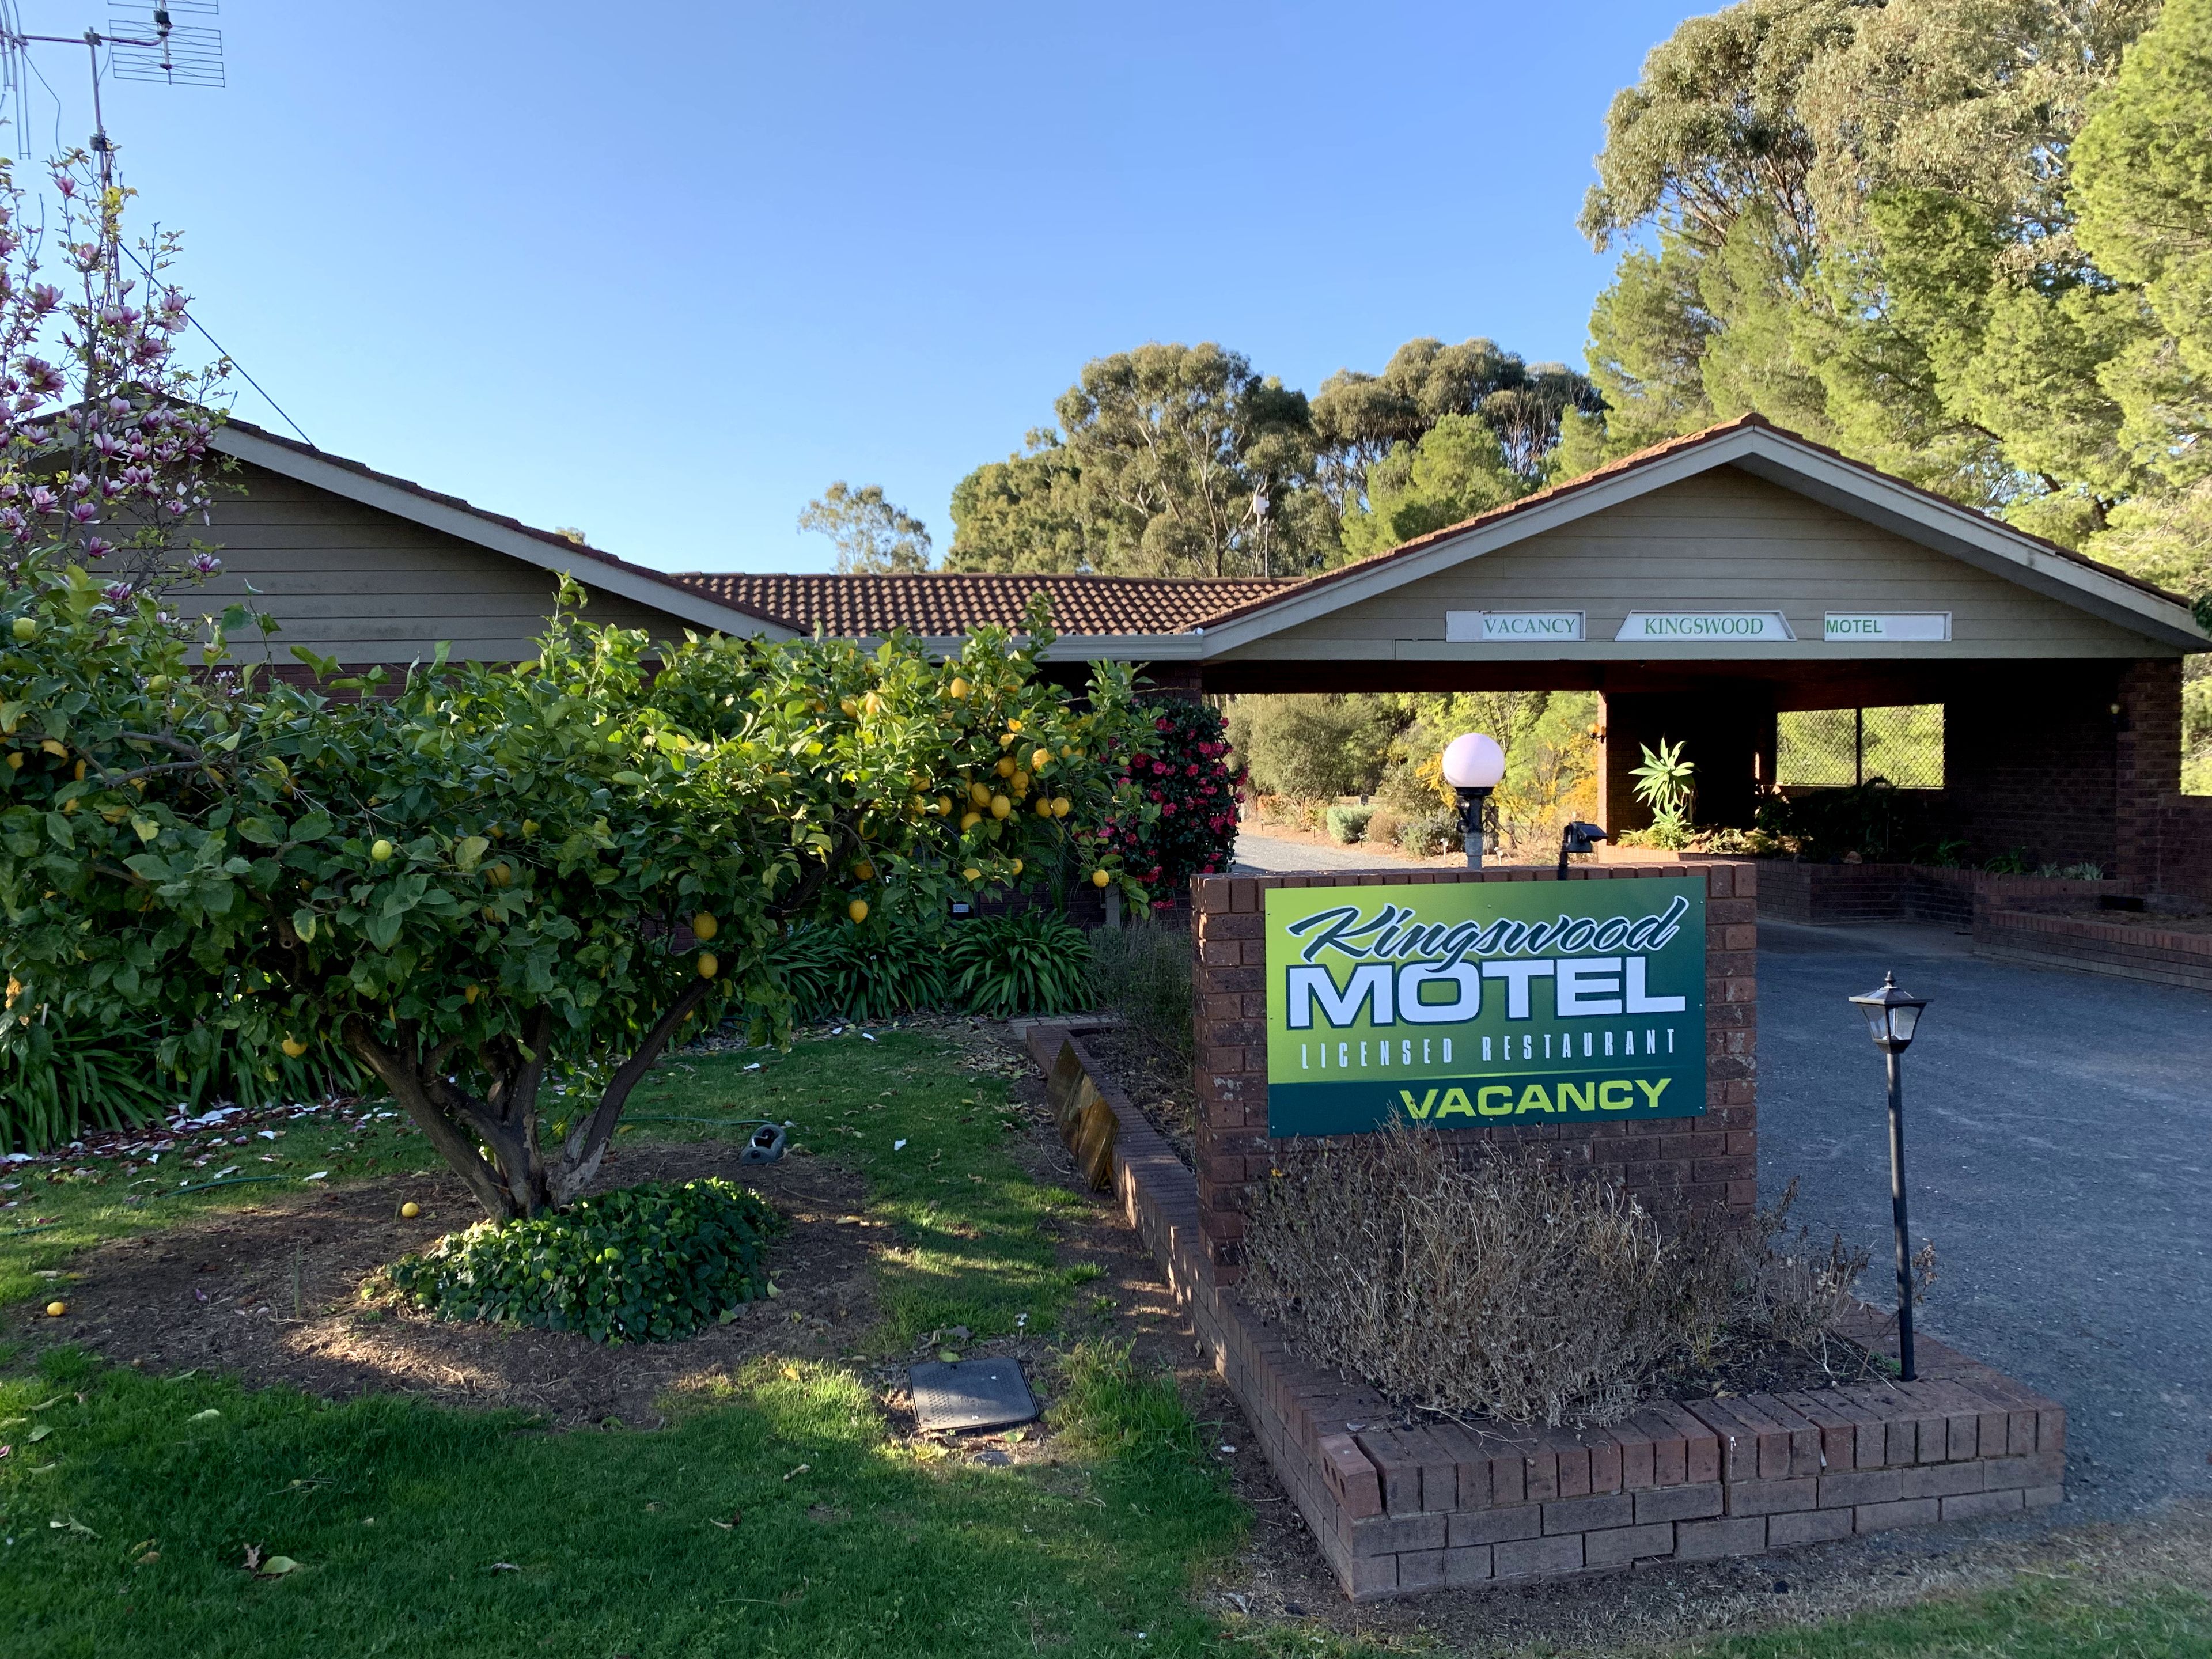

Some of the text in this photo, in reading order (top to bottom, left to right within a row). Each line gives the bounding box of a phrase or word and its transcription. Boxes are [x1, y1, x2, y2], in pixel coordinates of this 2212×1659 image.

[1484, 618, 1575, 634] VACANCY
[1644, 617, 1764, 635] KINGSWOOD
[1825, 619, 1883, 634] MOTEL
[1287, 896, 1690, 972] Kingswood
[1287, 956, 1687, 1029] MOTEL
[1301, 1029, 1675, 1069] LICENSED RESTAURANT
[1400, 1078, 1672, 1120] VACANCY
